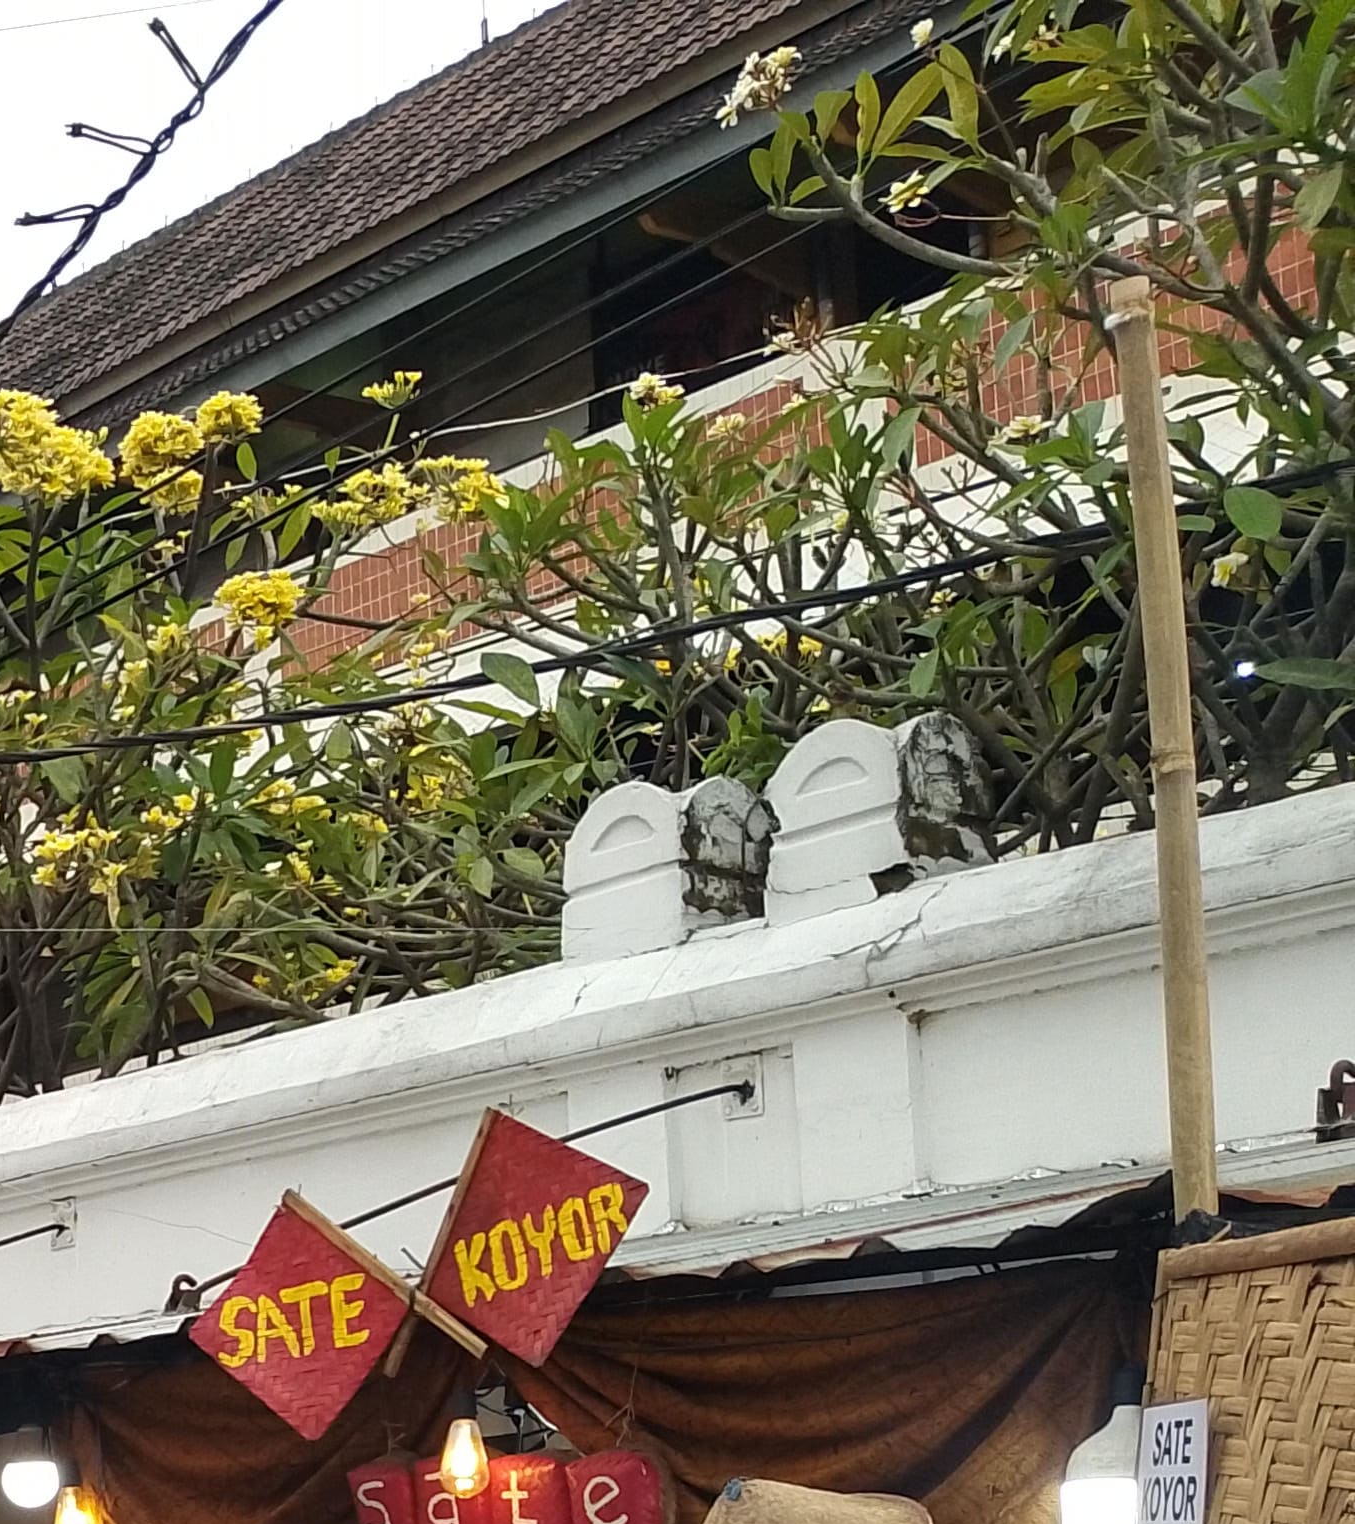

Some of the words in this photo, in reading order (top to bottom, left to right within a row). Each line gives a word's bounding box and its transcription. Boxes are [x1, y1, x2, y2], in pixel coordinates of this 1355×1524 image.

[453, 1181, 629, 1307] KOYOR
[217, 1272, 371, 1368] SATE
[1151, 1418, 1194, 1467] SATE
[1140, 1475, 1198, 1522] KOYOR
